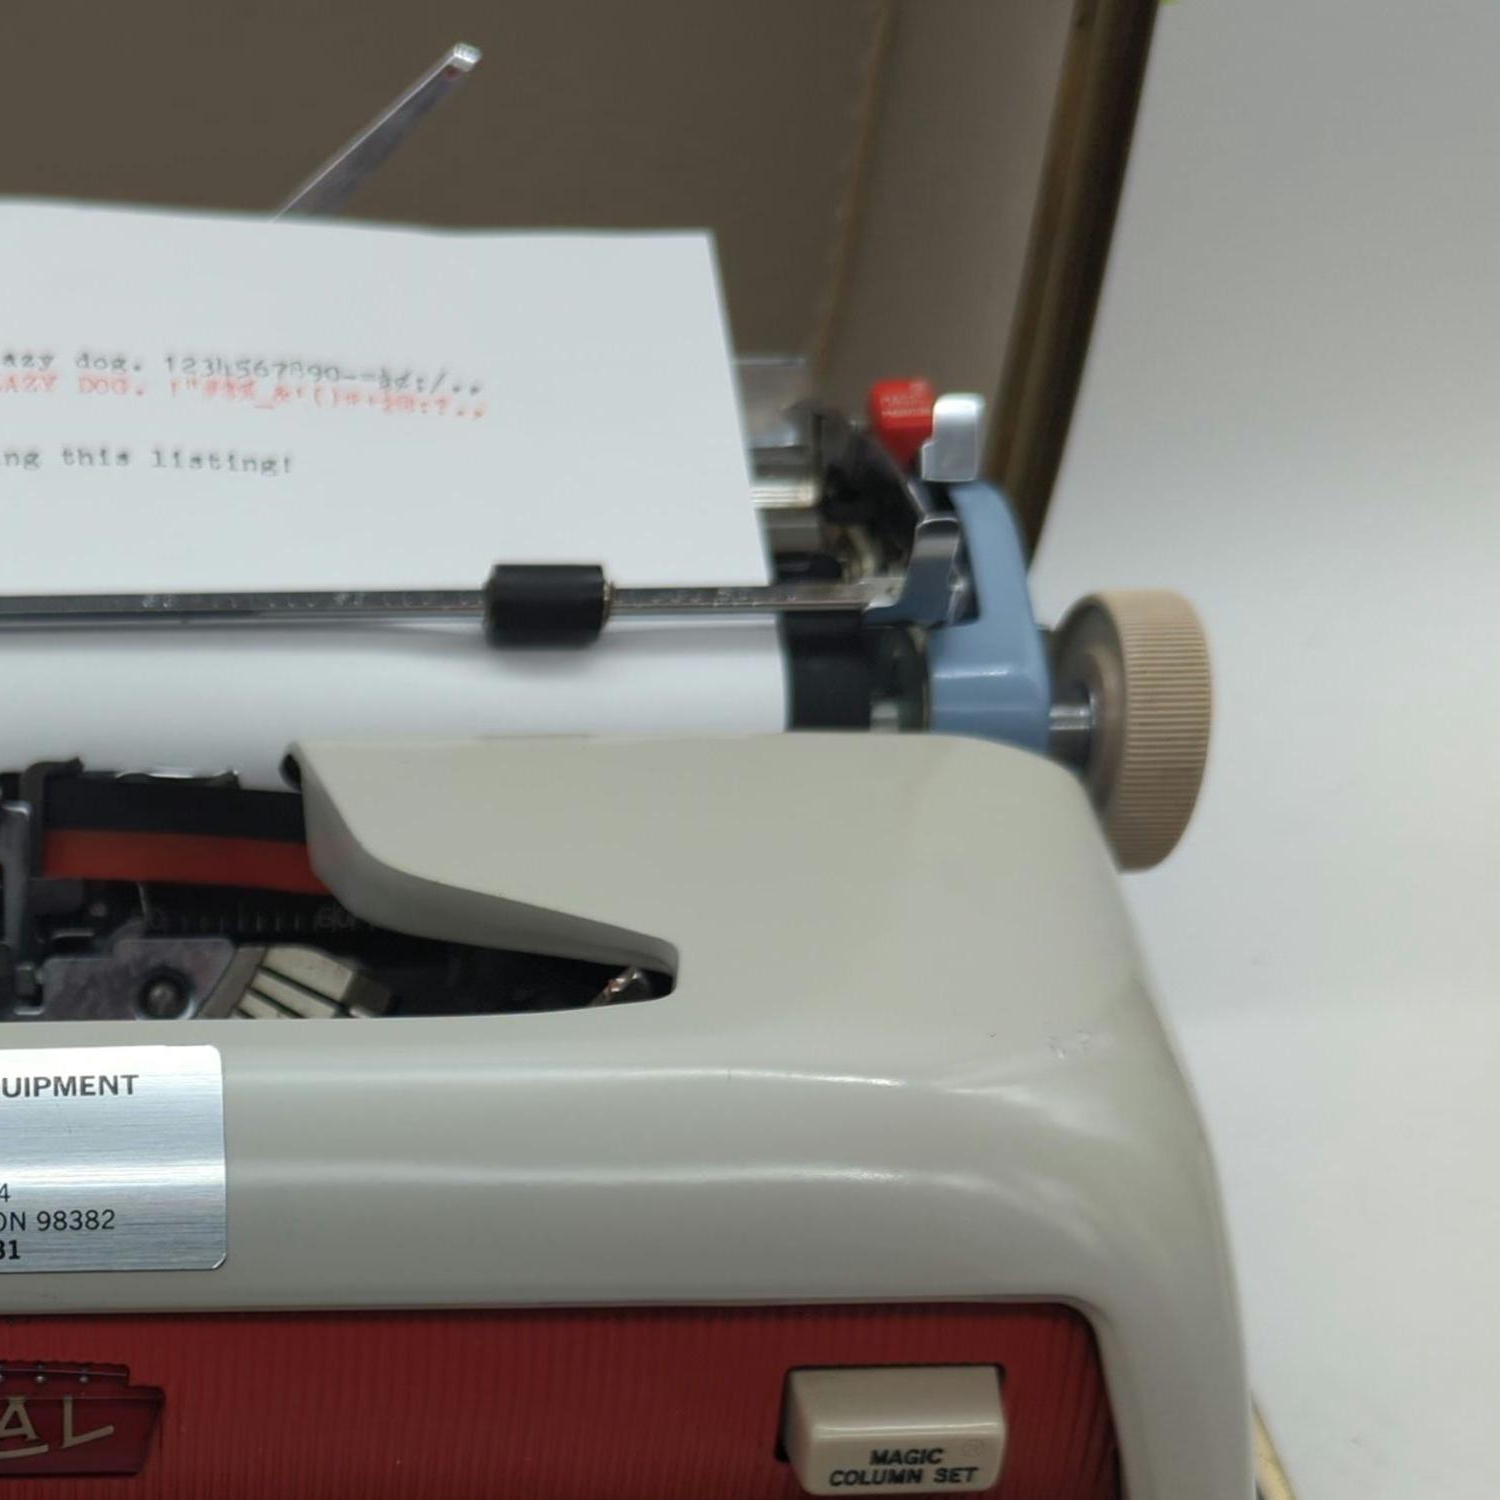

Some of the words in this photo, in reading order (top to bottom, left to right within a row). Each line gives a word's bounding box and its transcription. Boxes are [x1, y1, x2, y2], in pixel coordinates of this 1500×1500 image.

[75, 352, 142, 374] dog.
[78, 374, 144, 397] DOG.
[61, 447, 131, 467] this
[150, 448, 294, 477] listing!
[36, 1208, 116, 1233] 98382
[869, 1447, 945, 1466] MAGIC
[829, 1468, 924, 1487] COLUMN
[933, 1466, 979, 1484] SET
